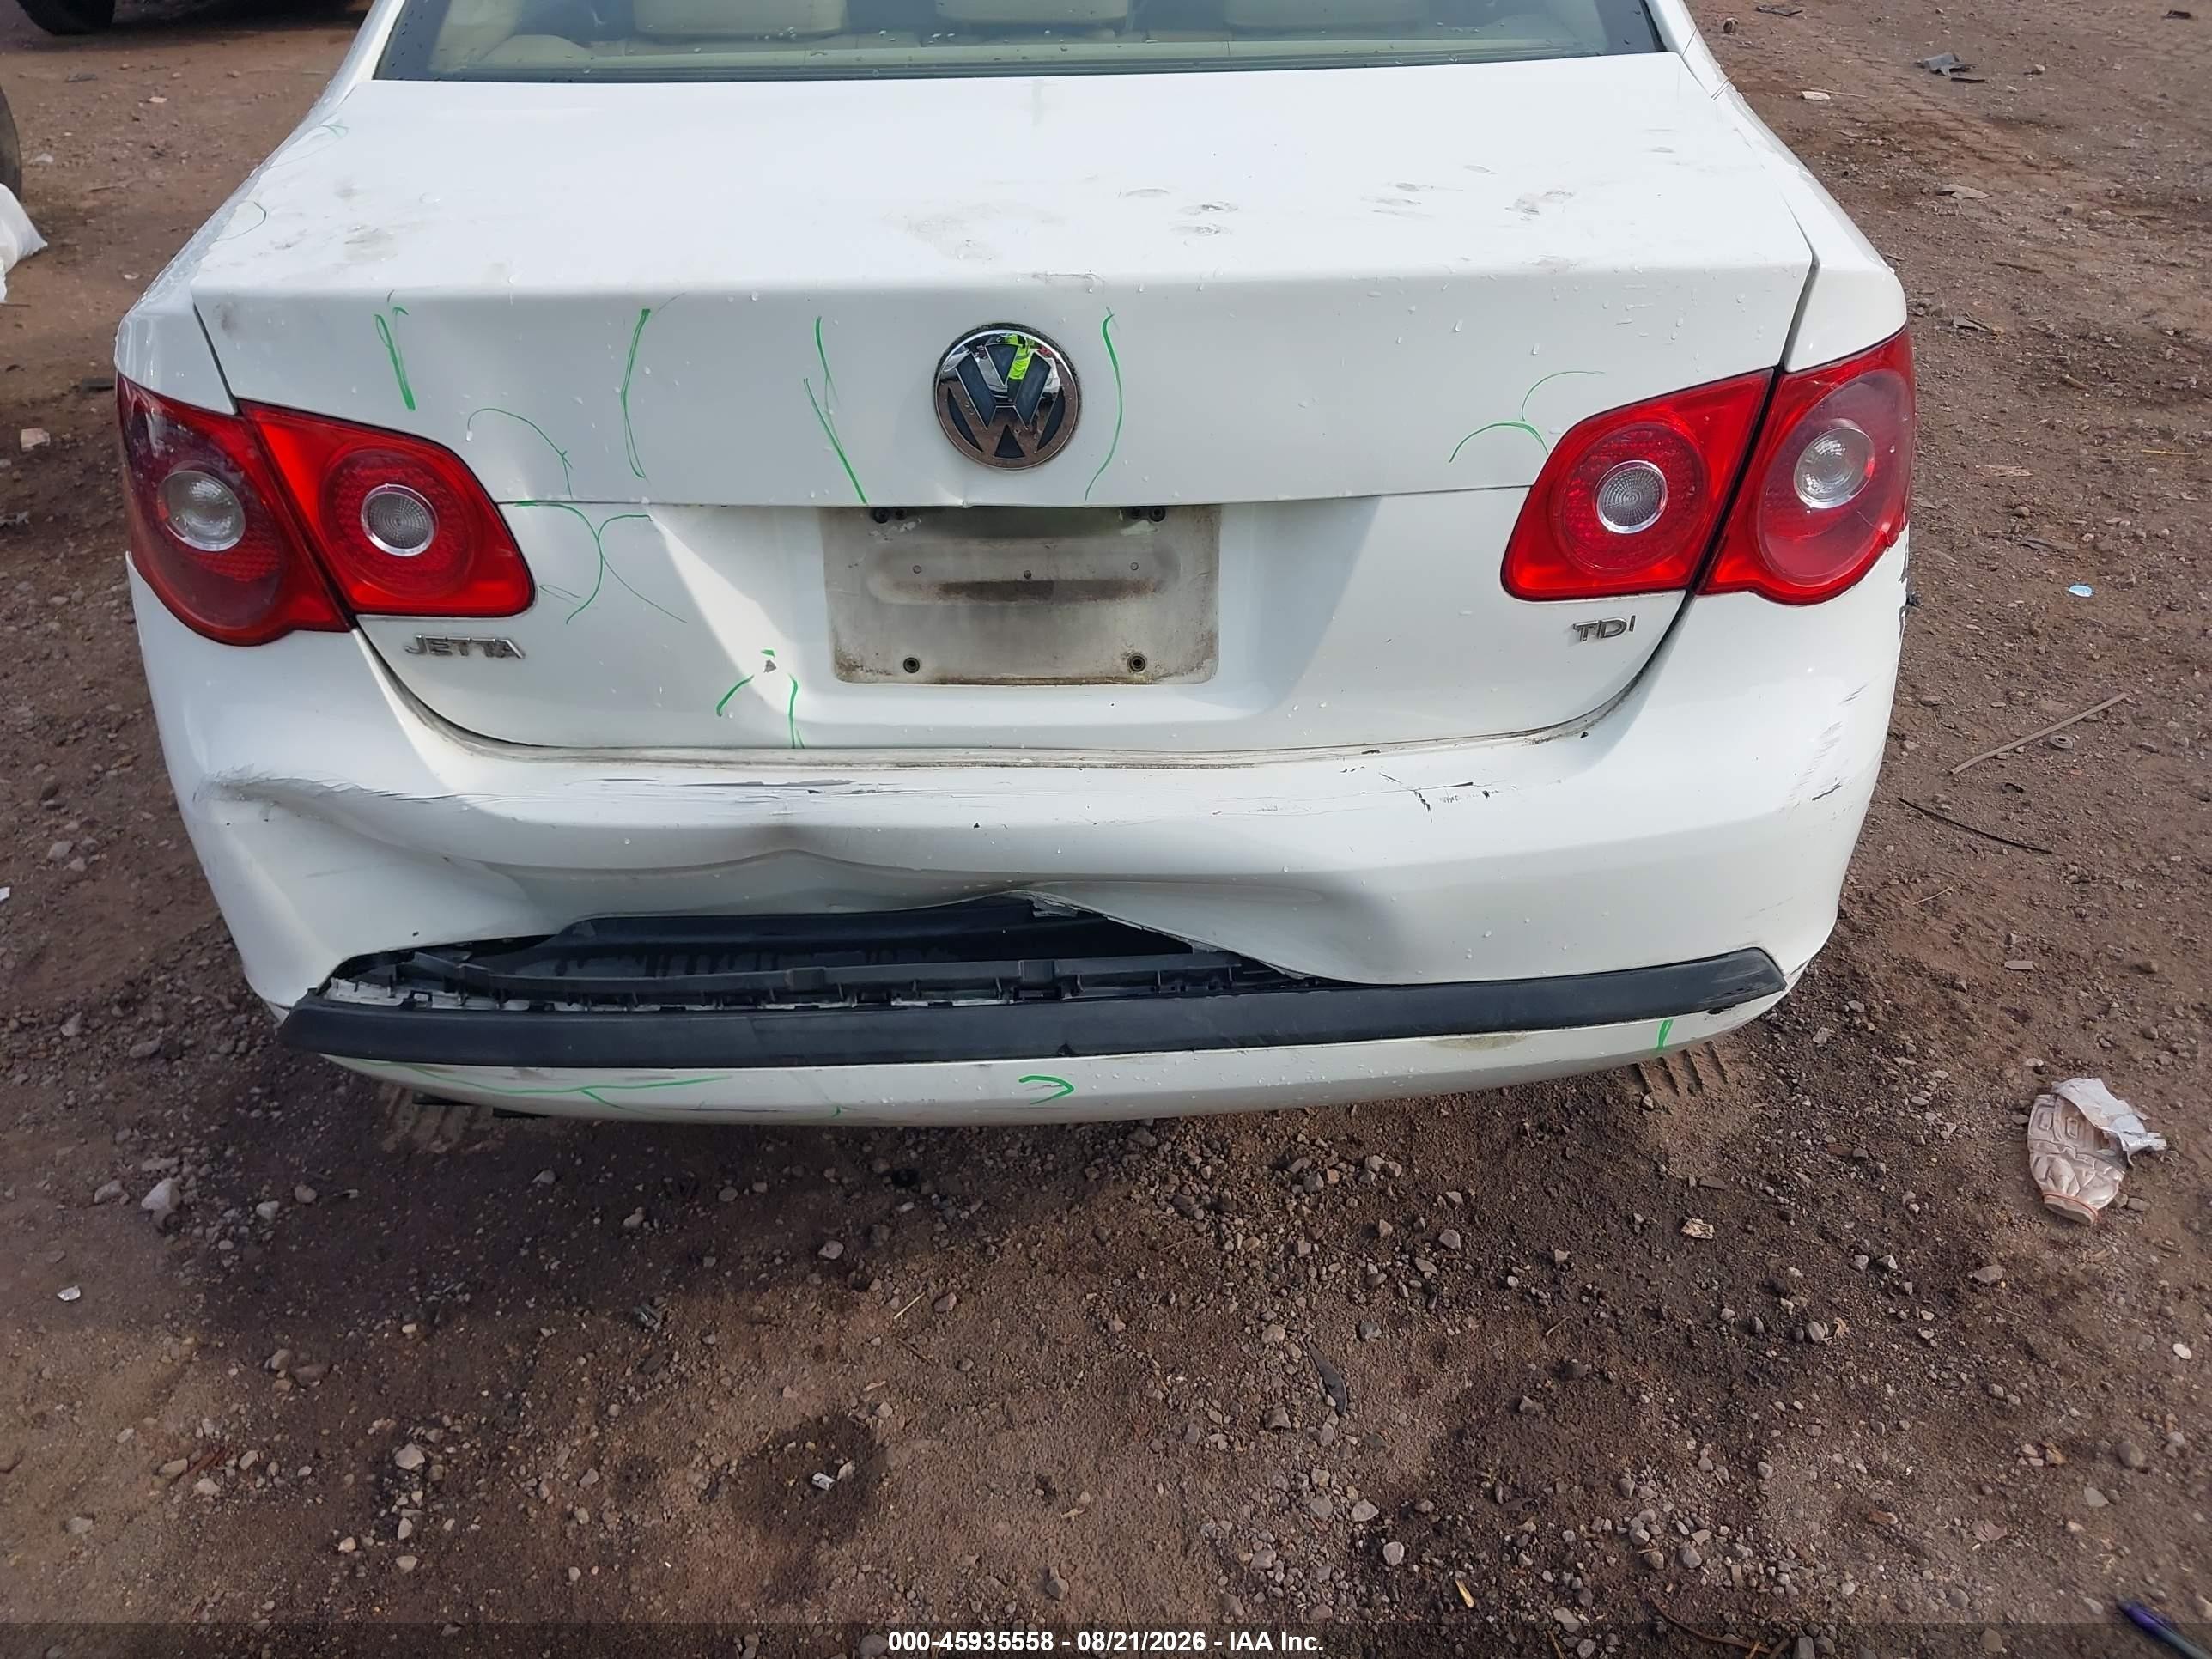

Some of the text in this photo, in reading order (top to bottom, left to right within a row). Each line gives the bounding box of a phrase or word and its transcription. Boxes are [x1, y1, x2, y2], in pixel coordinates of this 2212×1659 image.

[937, 326, 1079, 470] VW
[1572, 614, 1636, 642] TDI
[404, 634, 526, 659] JETTA
